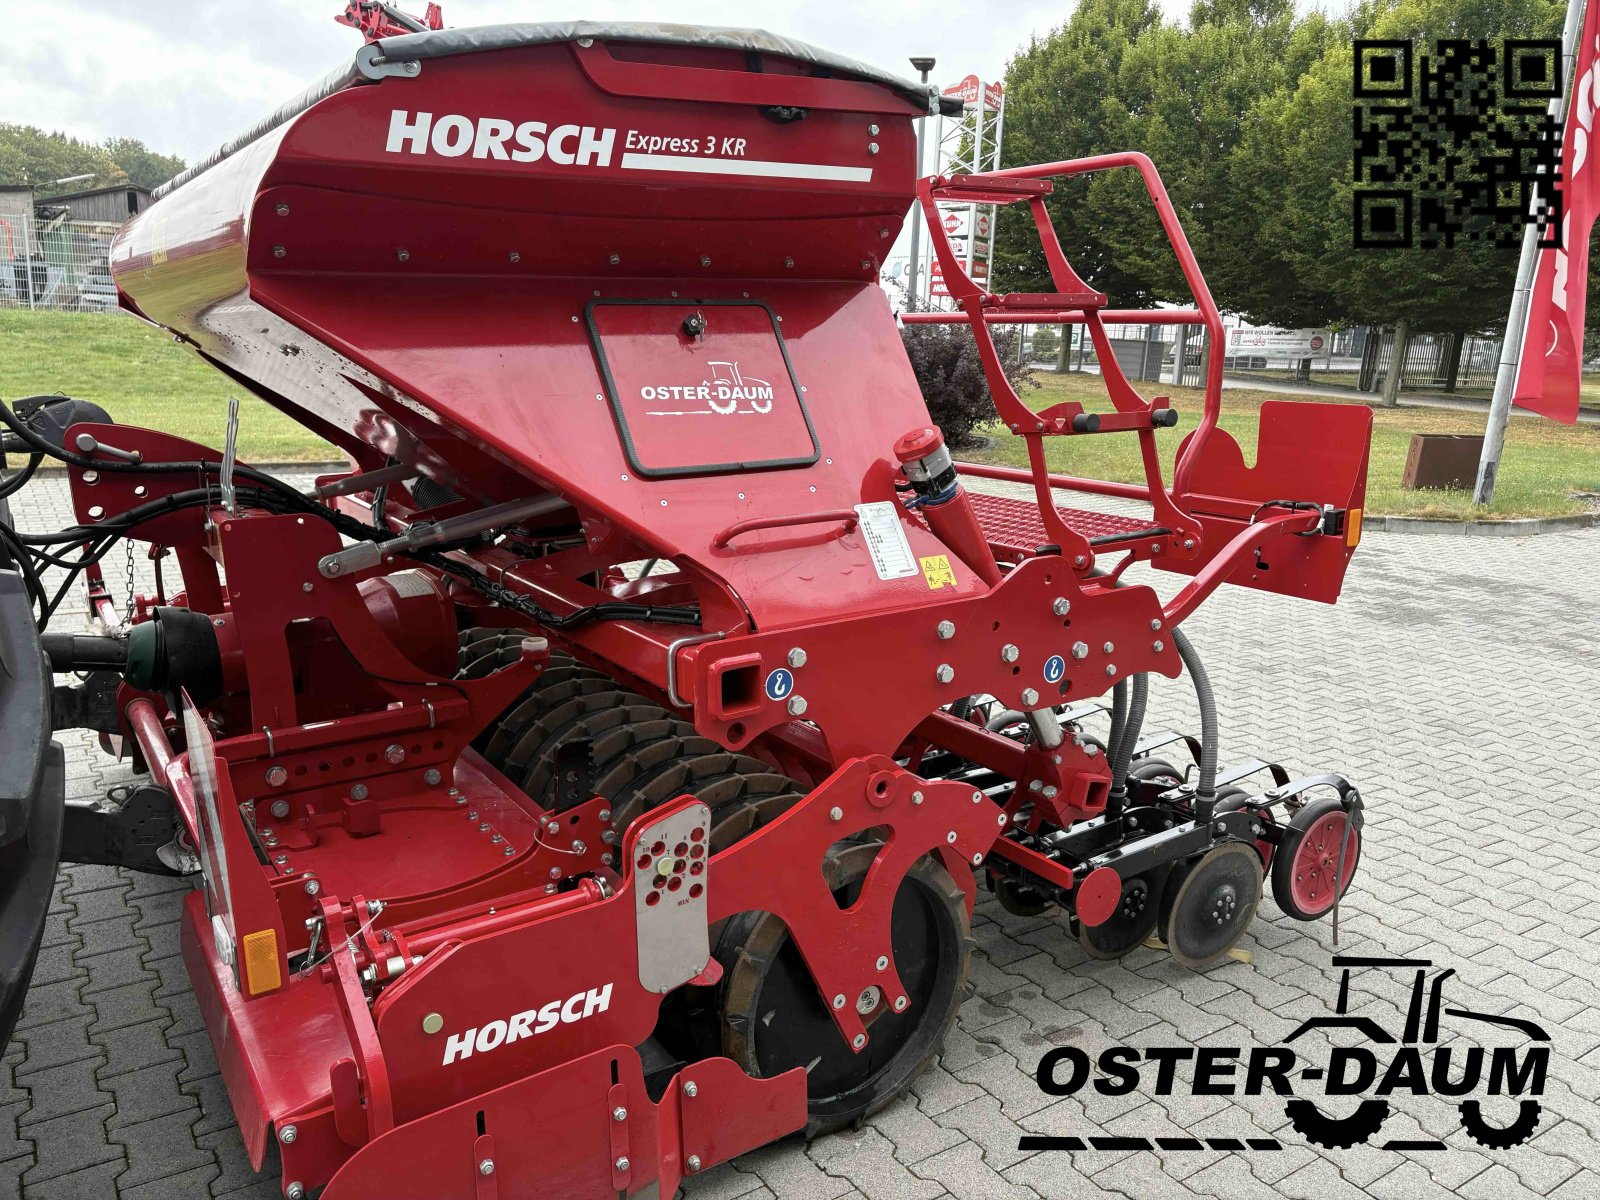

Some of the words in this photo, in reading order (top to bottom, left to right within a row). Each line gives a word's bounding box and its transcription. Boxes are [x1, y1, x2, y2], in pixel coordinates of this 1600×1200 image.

[385, 109, 616, 167] HORSCH
[625, 130, 699, 154] Express
[704, 136, 715, 155] 3
[721, 137, 747, 156] KR
[640, 386, 774, 400] OSTER-DAUM
[442, 983, 614, 1066] HORSCH
